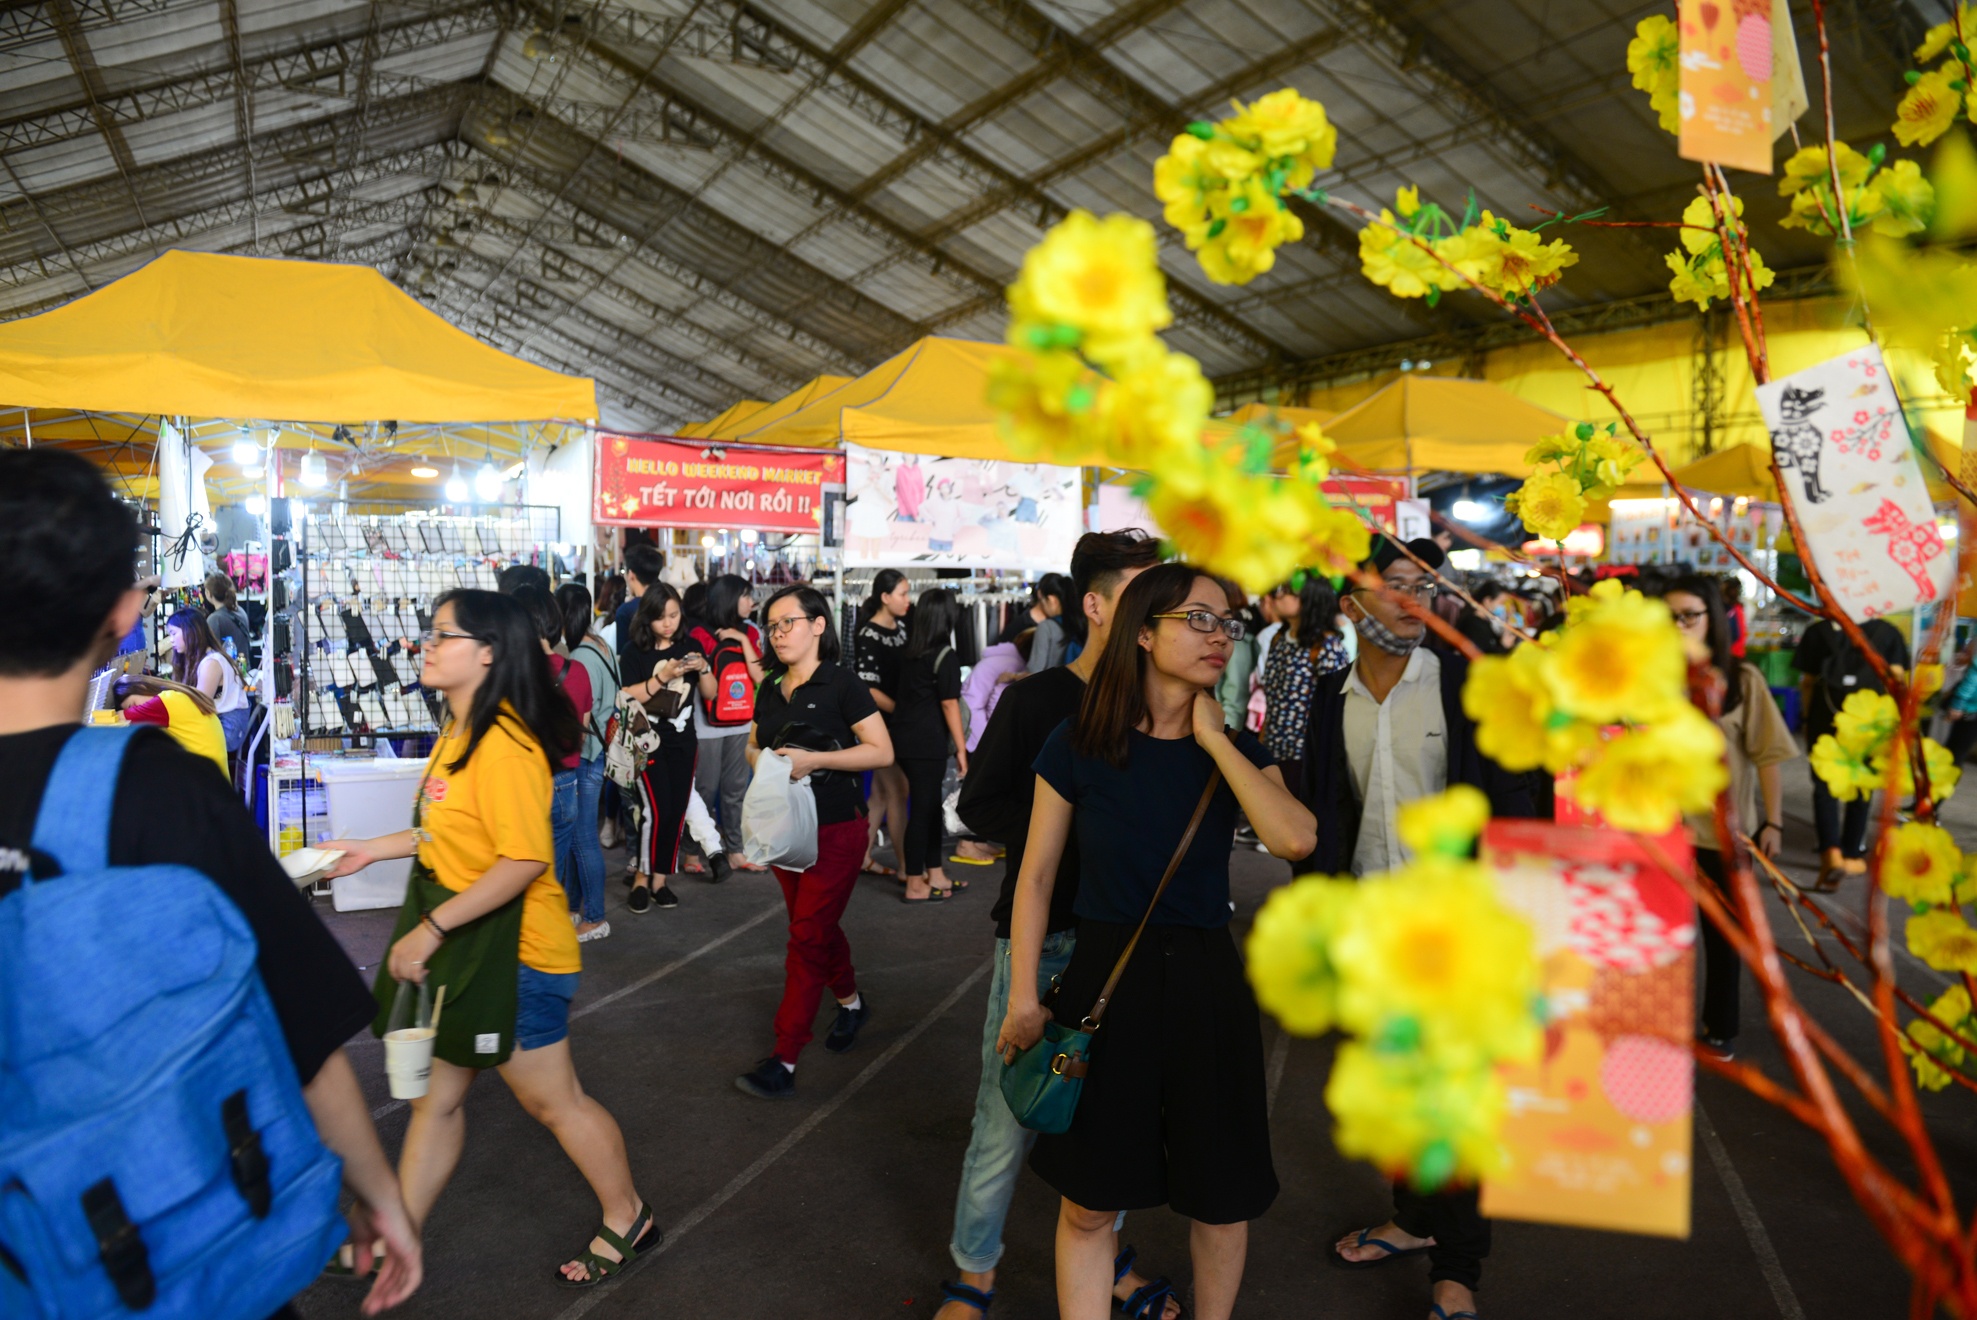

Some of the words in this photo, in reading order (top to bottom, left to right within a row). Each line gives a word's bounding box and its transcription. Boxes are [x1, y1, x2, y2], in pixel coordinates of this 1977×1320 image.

[626, 457, 679, 477] HELLO
[682, 461, 759, 482] WEEKEND
[762, 466, 823, 485] MARKET
[639, 480, 678, 507] TẾT
[683, 485, 716, 510] TỚI
[720, 489, 755, 511] NƠI
